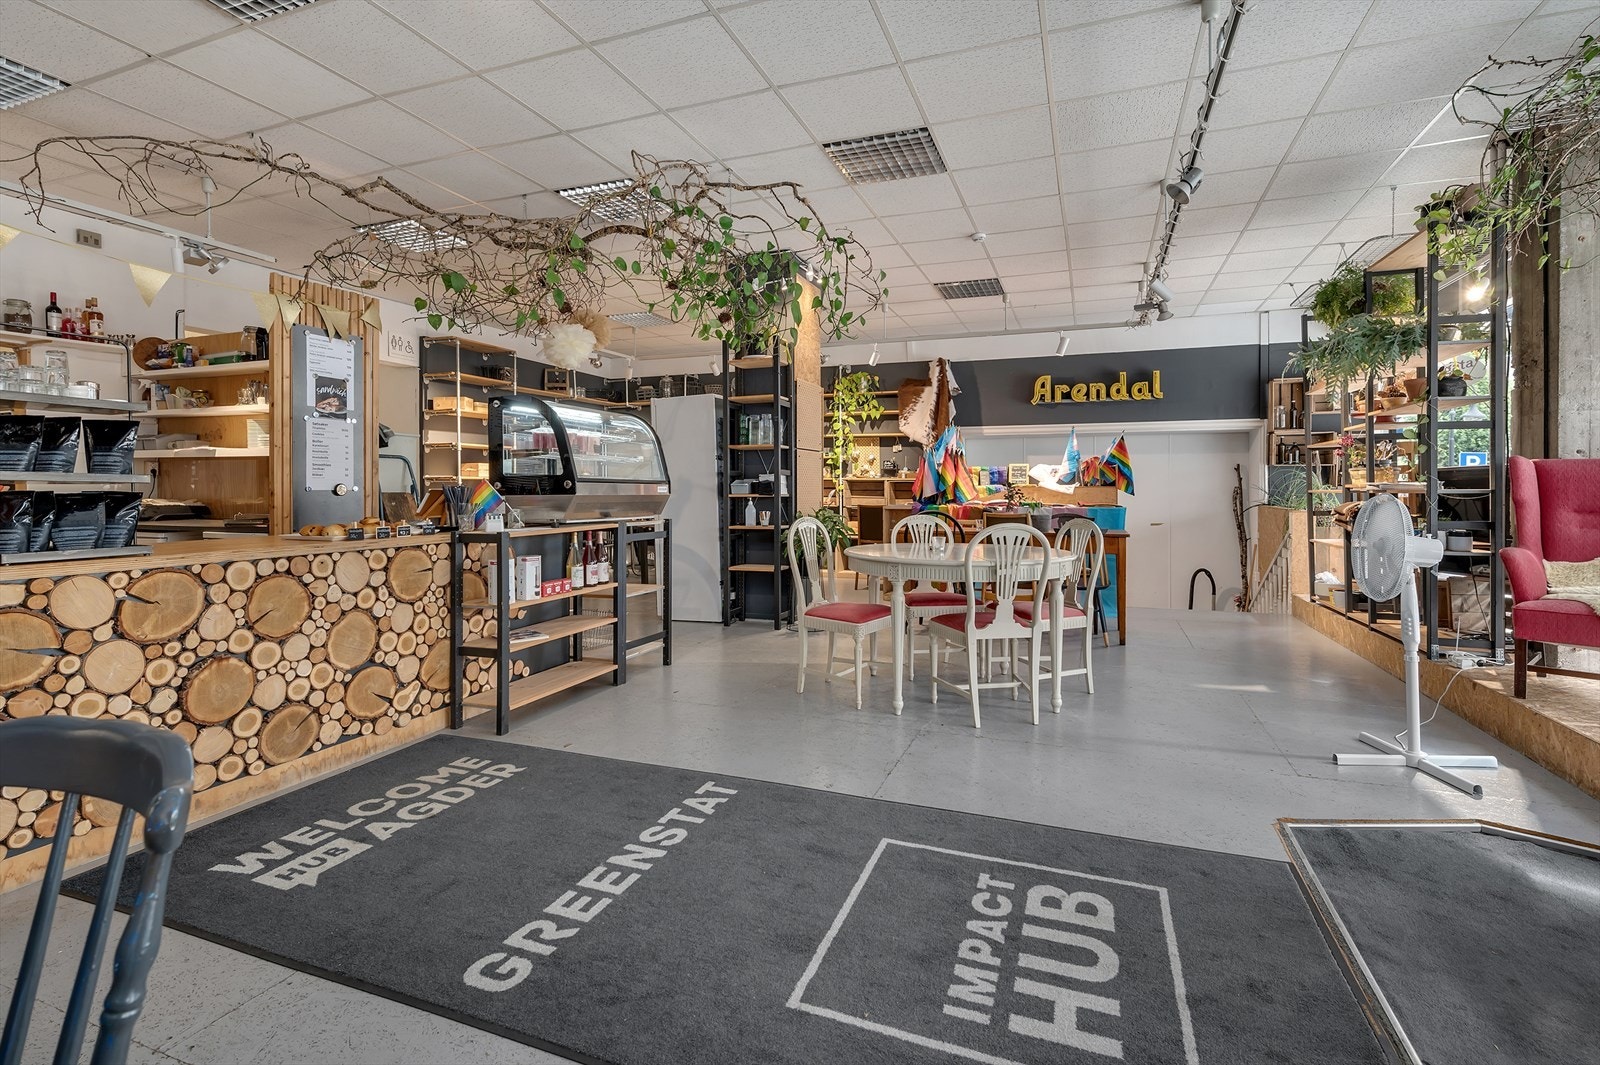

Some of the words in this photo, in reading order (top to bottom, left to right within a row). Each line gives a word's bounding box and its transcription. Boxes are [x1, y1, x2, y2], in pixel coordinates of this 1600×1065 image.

[1030, 370, 1164, 405] Arendal
[1465, 455, 1481, 467] P
[207, 756, 492, 874] WELCOME
[364, 763, 528, 841] AGDER
[462, 781, 738, 993] GREENSTAT
[943, 873, 1015, 1025] IMPACT
[1008, 884, 1124, 1060] HUB
